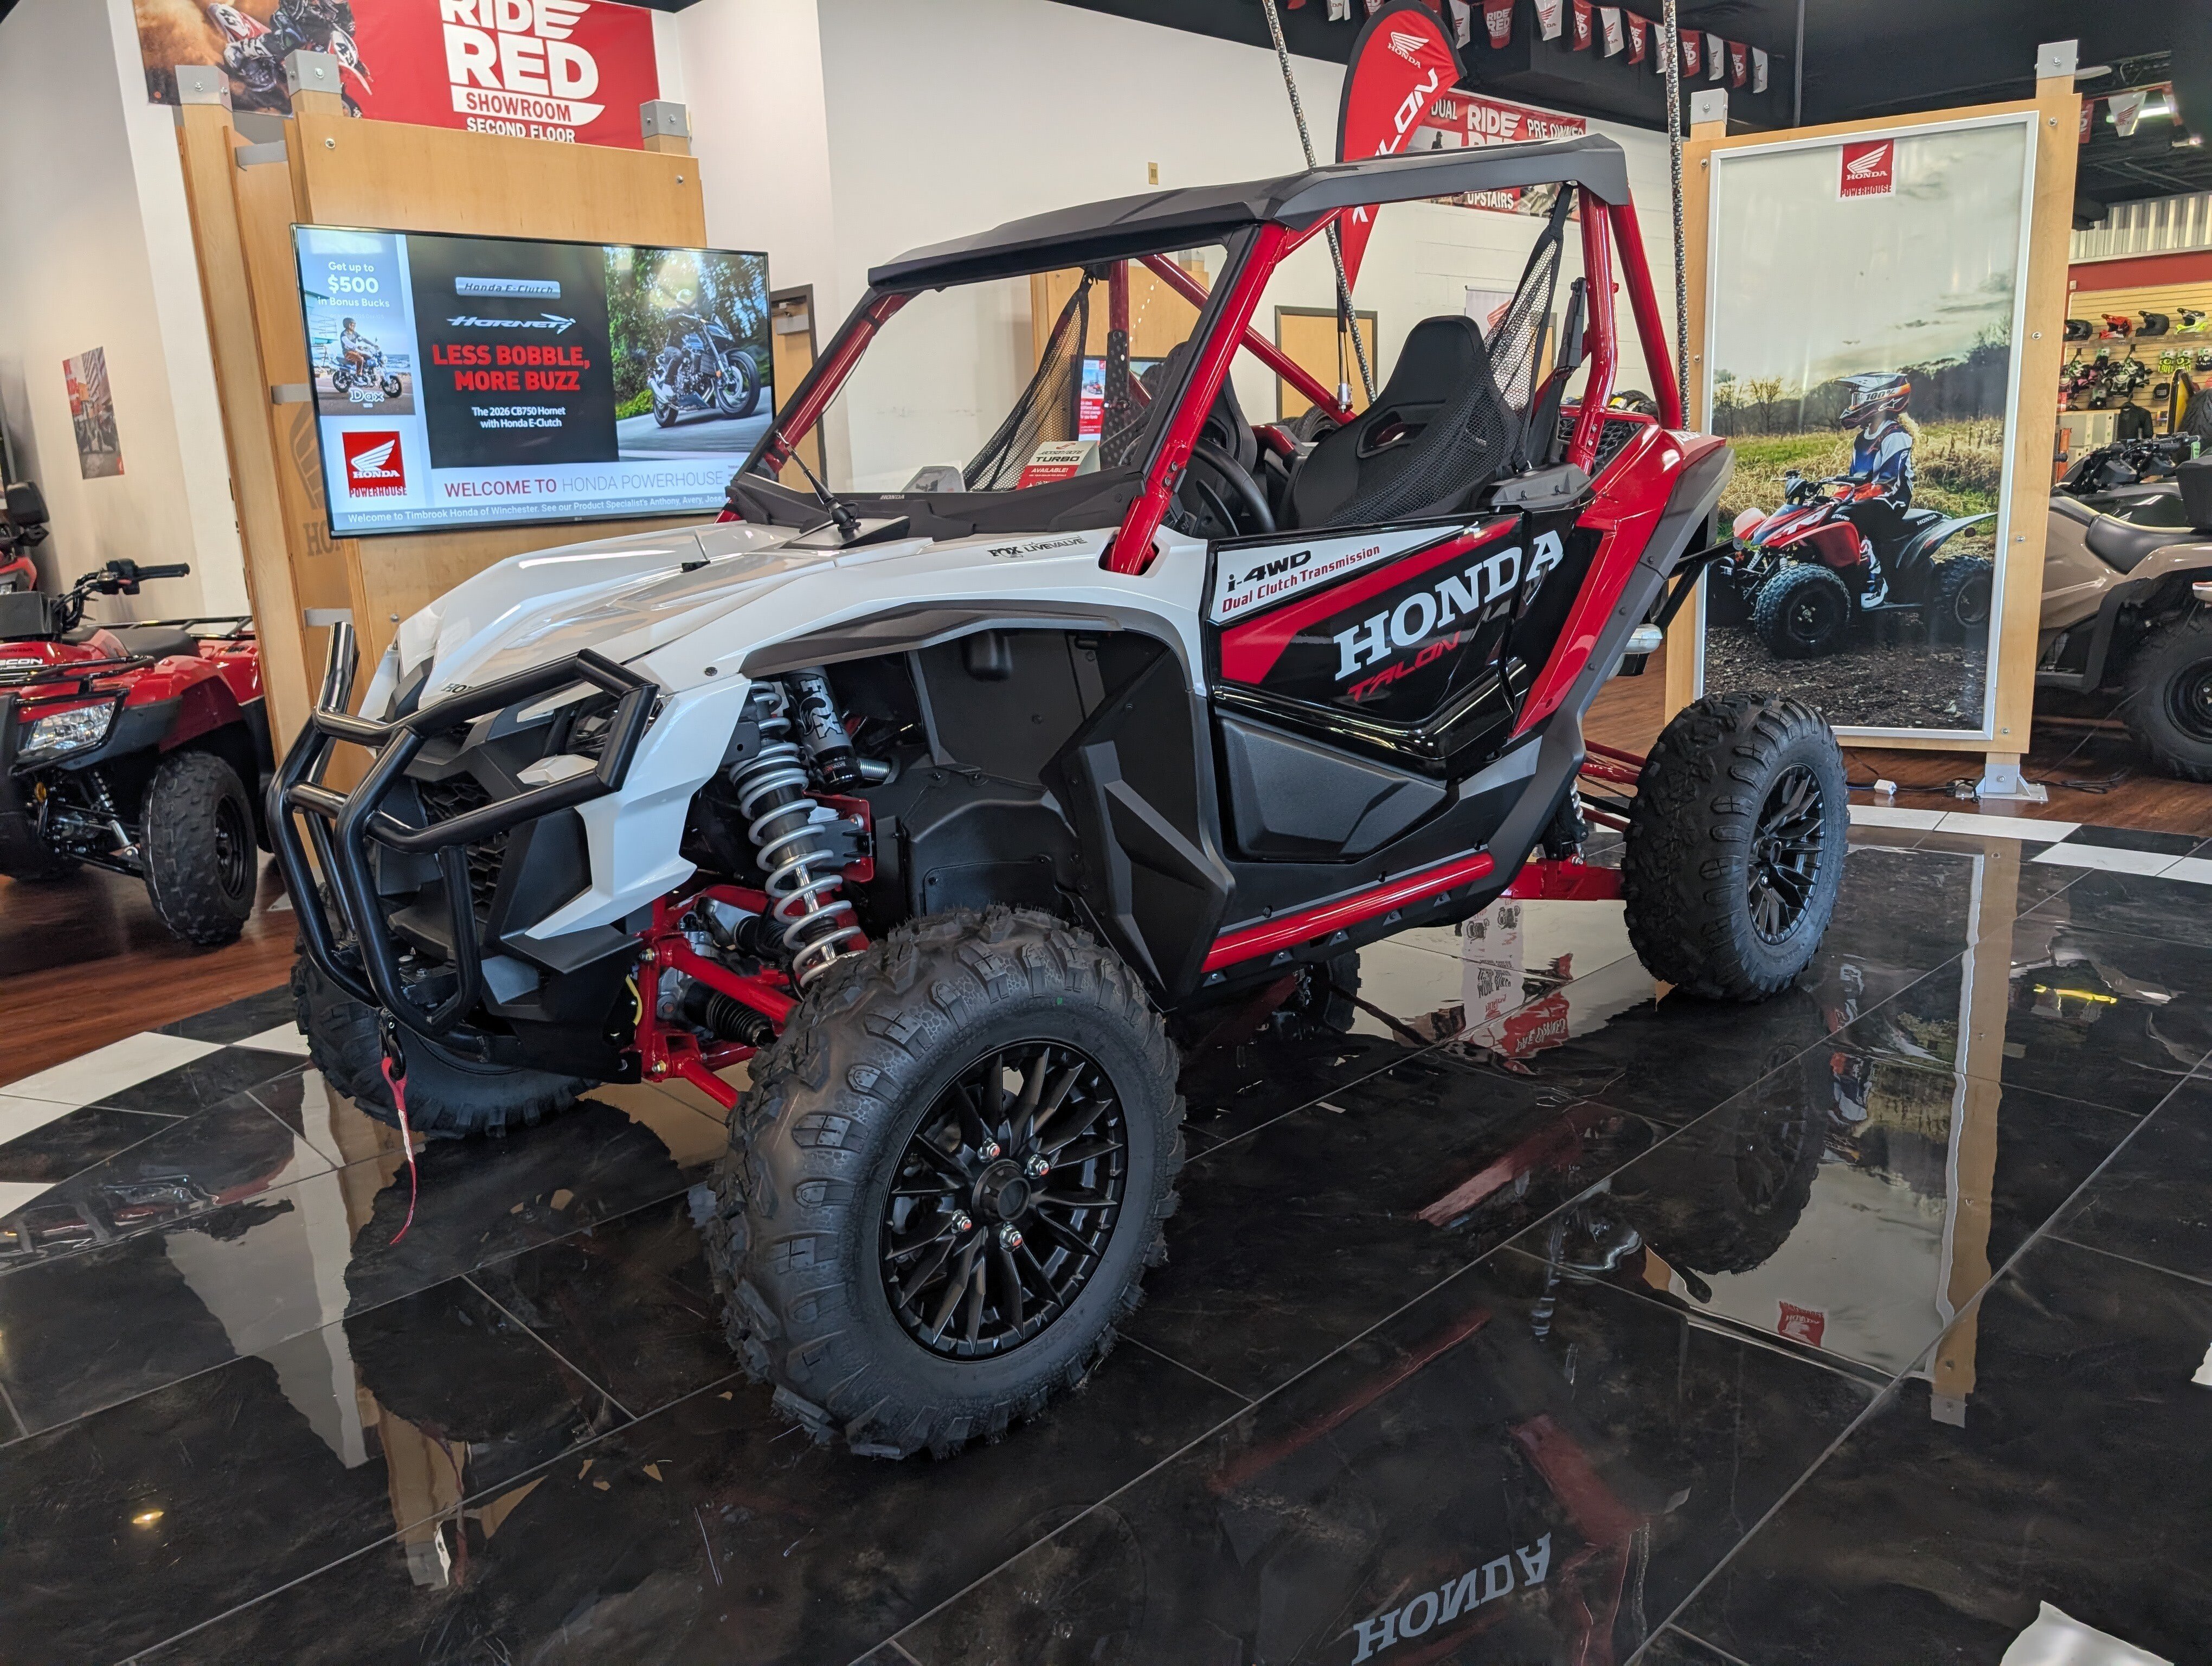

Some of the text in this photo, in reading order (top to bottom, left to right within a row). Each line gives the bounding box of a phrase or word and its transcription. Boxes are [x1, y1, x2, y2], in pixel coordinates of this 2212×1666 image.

[440, 0, 591, 40] RIDE
[1486, 8, 1512, 22] RIDE
[1487, 17, 1510, 32] RED
[442, 23, 599, 99] RED
[1387, 42, 1421, 68] HONDA
[466, 92, 572, 123] SHOWROOM
[466, 117, 576, 143] SECOND FLOOR
[1467, 104, 1522, 137] RIDE
[1527, 118, 1547, 139] PRE
[1846, 170, 1888, 181] HONDA
[1467, 192, 1514, 210] UPSTAIRS
[1840, 184, 1892, 198] POWERHOUSE
[328, 261, 375, 273] Get up to
[327, 274, 379, 293] $500
[464, 283, 553, 294] Honda E-Clutch
[317, 296, 390, 308] in Bonus Bucks
[432, 344, 590, 369] LESS BOBBLE,
[454, 370, 581, 391] MORE BUZZ
[349, 388, 384, 402] Dax
[1866, 389, 1895, 401] 100%
[472, 407, 566, 416] The 2026 CB750 Hornet
[480, 418, 563, 428] with Honda E-Clutch
[352, 469, 400, 479] HONDA
[445, 471, 723, 497] WELCOME TO HONDA POWERHOUSE
[349, 486, 407, 498] POWERHOUSE
[348, 514, 391, 523] Welcome
[394, 513, 403, 521] to
[405, 510, 447, 520] Timbrook
[450, 509, 478, 518] Honda
[480, 507, 489, 516] of
[491, 505, 540, 515] Winchester.
[542, 503, 557, 512] See
[574, 501, 604, 510] Product
[606, 498, 648, 510] Specialist's
[650, 498, 681, 507] Anthony,
[683, 496, 704, 505] Avery,
[705, 495, 724, 503] Jose,
[1917, 514, 1938, 526] HONDA
[987, 537, 1088, 558] FOX LIVEVALVE
[1221, 546, 1380, 613] Dual Clutch Transmission
[1227, 550, 1311, 592] i-4WD
[1333, 530, 1564, 681] HONDA
[1348, 631, 1462, 702] TALON
[800, 677, 844, 740] FOX
